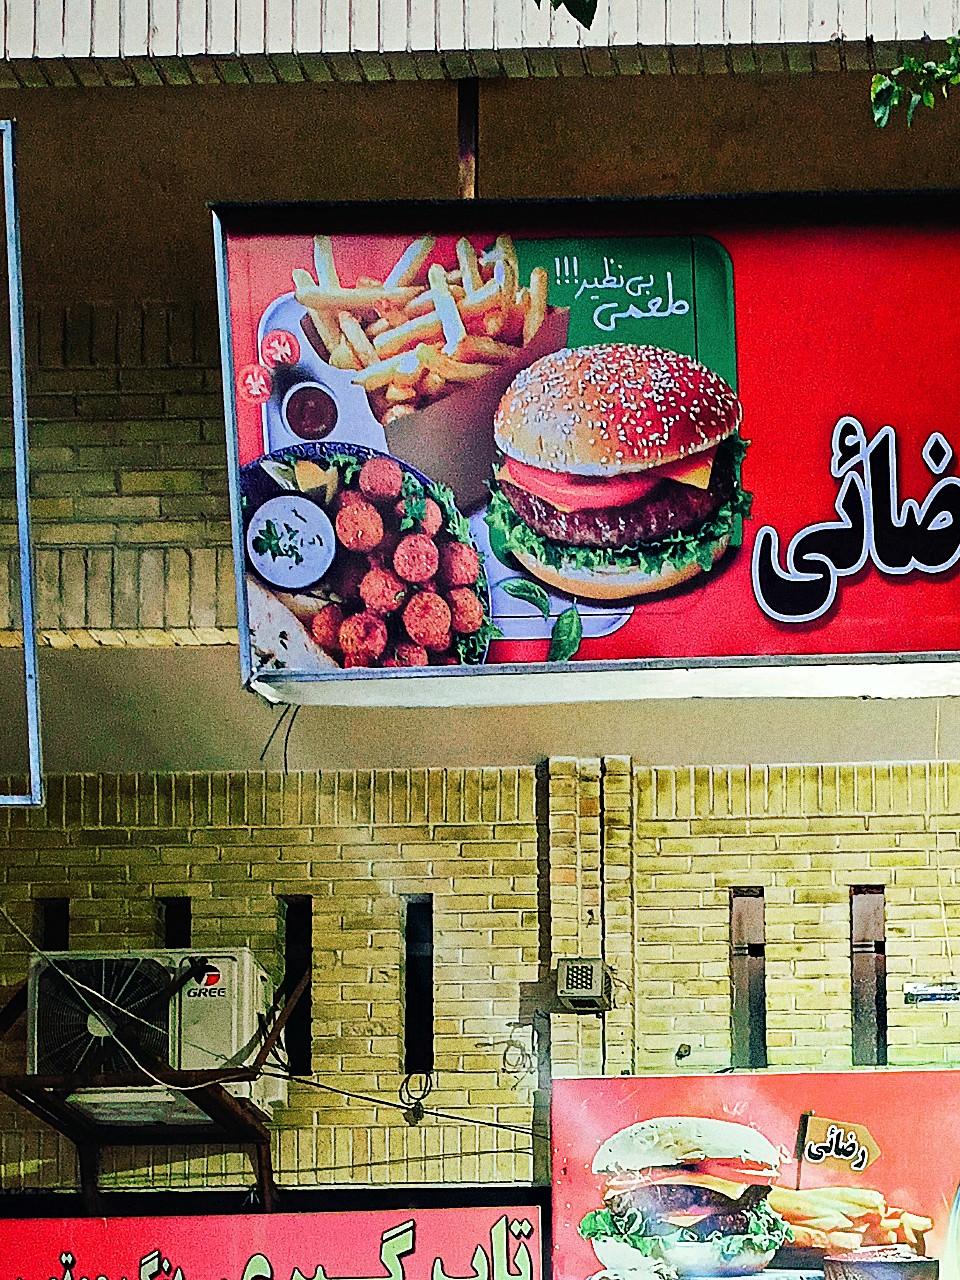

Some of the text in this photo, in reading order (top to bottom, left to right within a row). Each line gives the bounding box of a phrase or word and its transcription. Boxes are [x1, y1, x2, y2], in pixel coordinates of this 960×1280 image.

[592, 271, 690, 332] طعمی
[186, 987, 227, 998] GREE
[805, 1124, 870, 1171] رضائی
